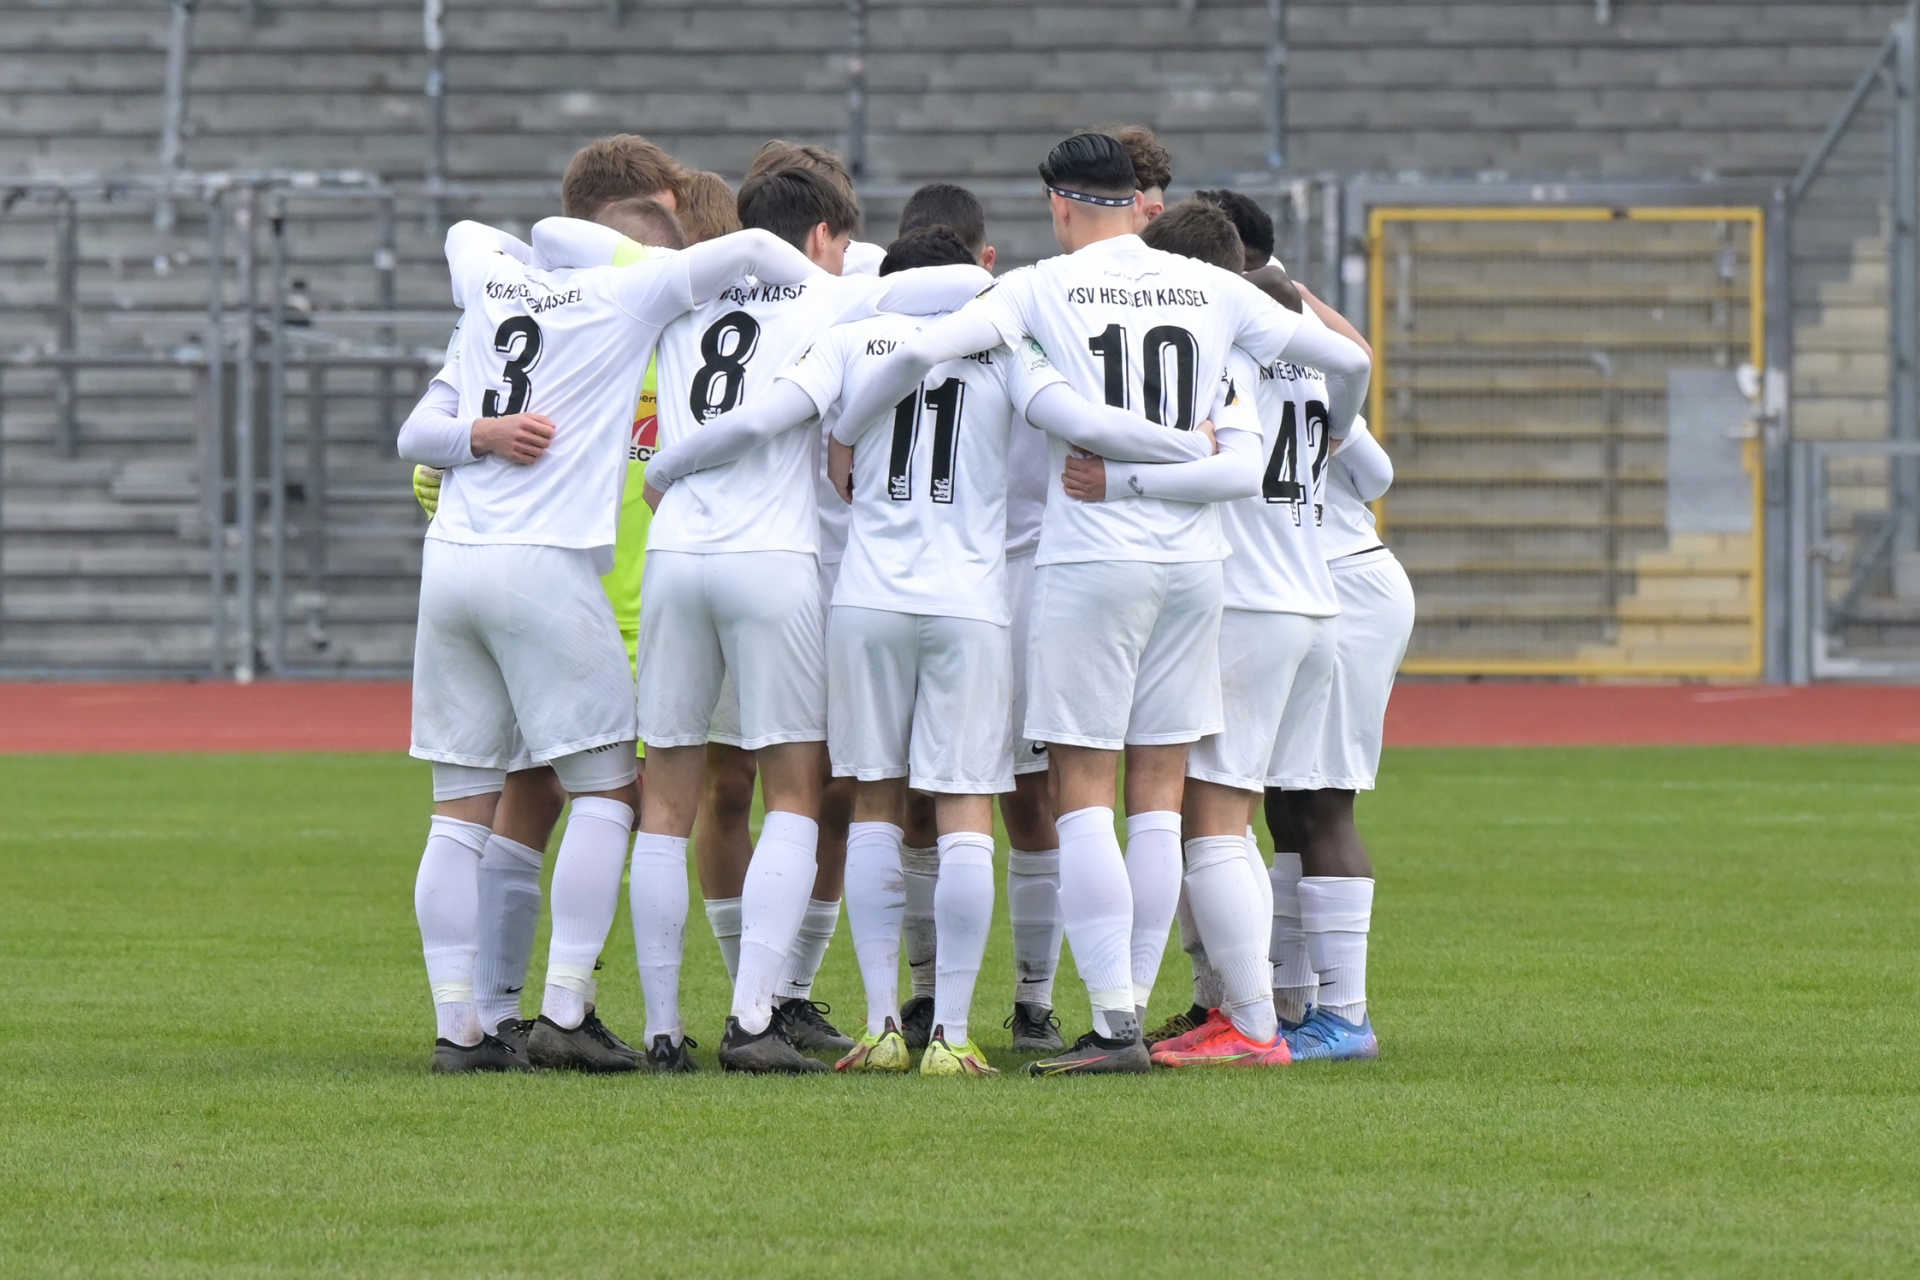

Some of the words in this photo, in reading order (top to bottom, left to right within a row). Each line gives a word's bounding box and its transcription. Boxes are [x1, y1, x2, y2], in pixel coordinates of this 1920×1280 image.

[538, 288, 583, 313] KASSEL
[866, 339, 897, 355] KSV
[1067, 287, 1095, 304] KSV
[1100, 287, 1153, 308] HESSEN
[1156, 288, 1209, 307] KASSEL
[482, 315, 544, 419] 3
[690, 310, 761, 425] 8
[1088, 324, 1200, 431] 10
[888, 377, 966, 504] 11
[1262, 400, 1329, 527] 42
